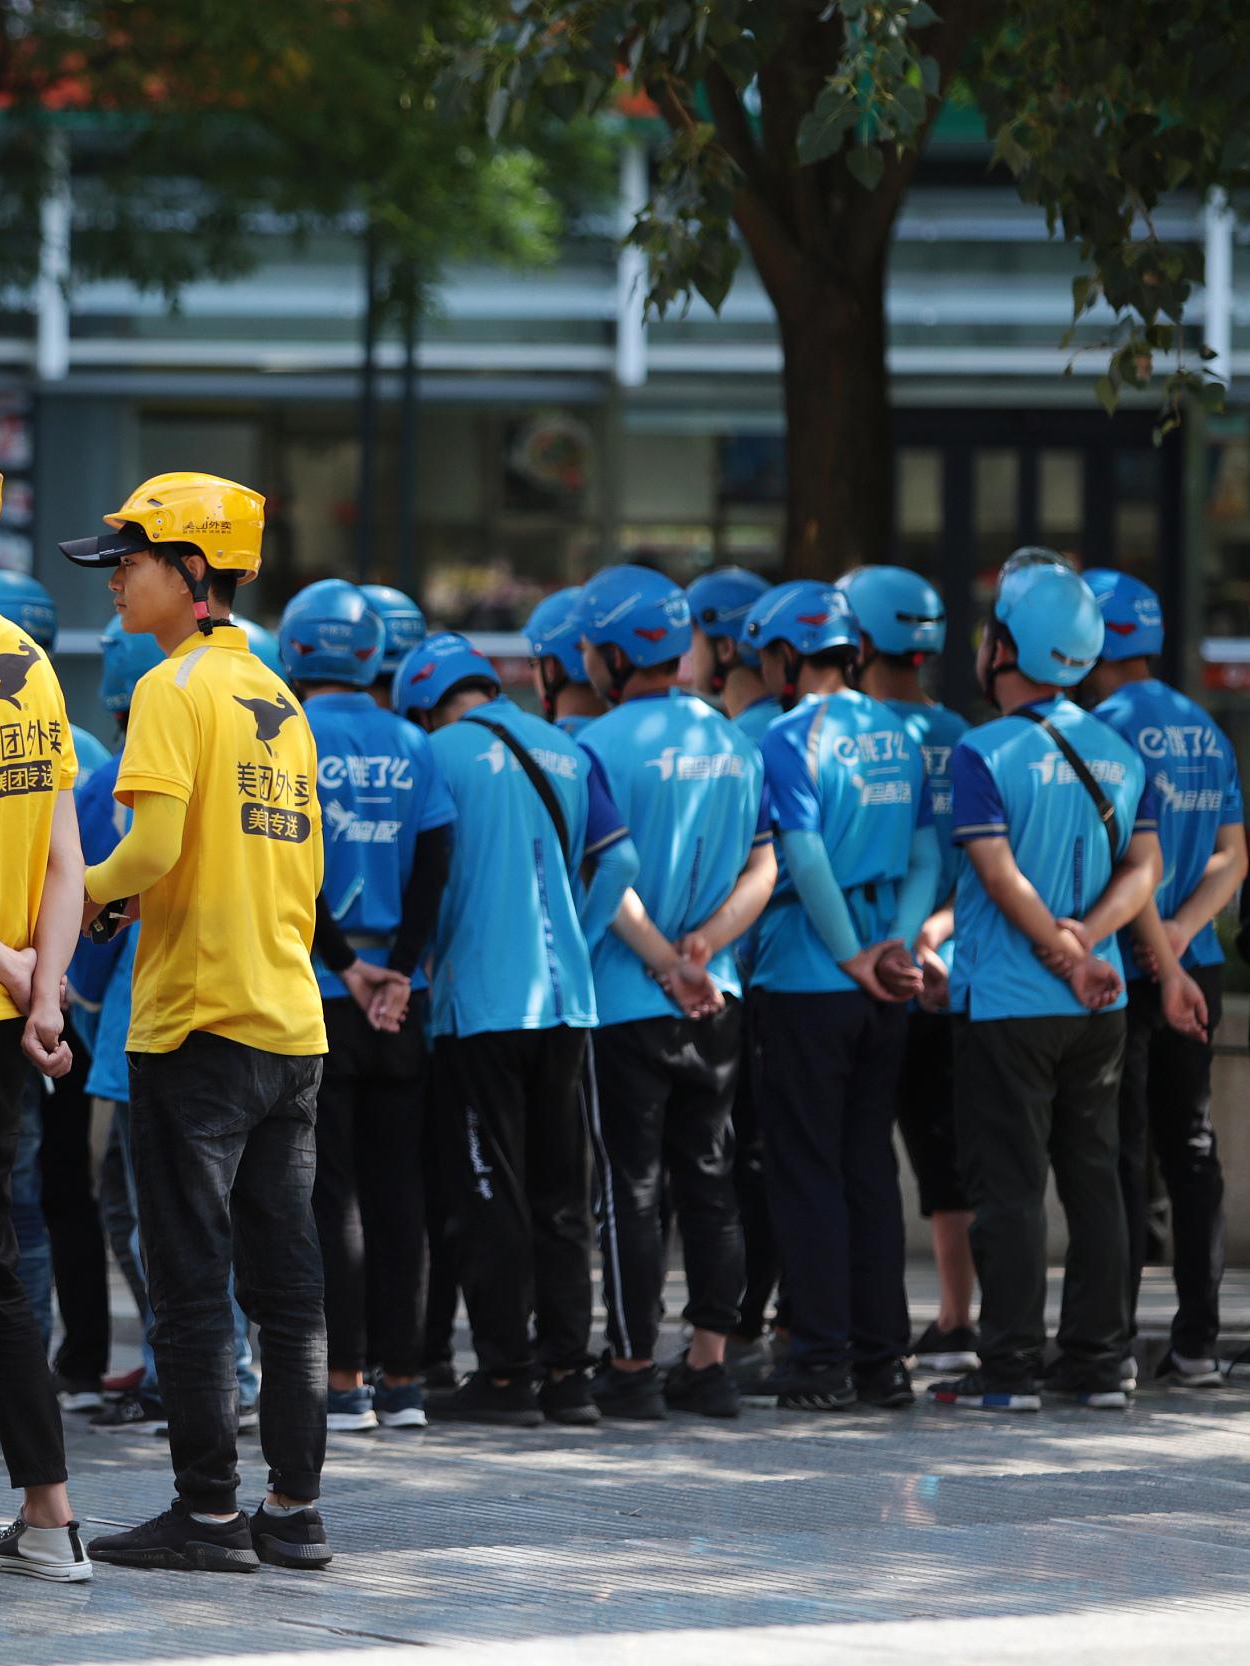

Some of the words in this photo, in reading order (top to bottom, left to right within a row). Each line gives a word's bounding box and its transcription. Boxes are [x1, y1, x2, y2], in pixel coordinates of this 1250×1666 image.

[237, 761, 311, 807] 美团外卖
[248, 807, 299, 839] 美专送
